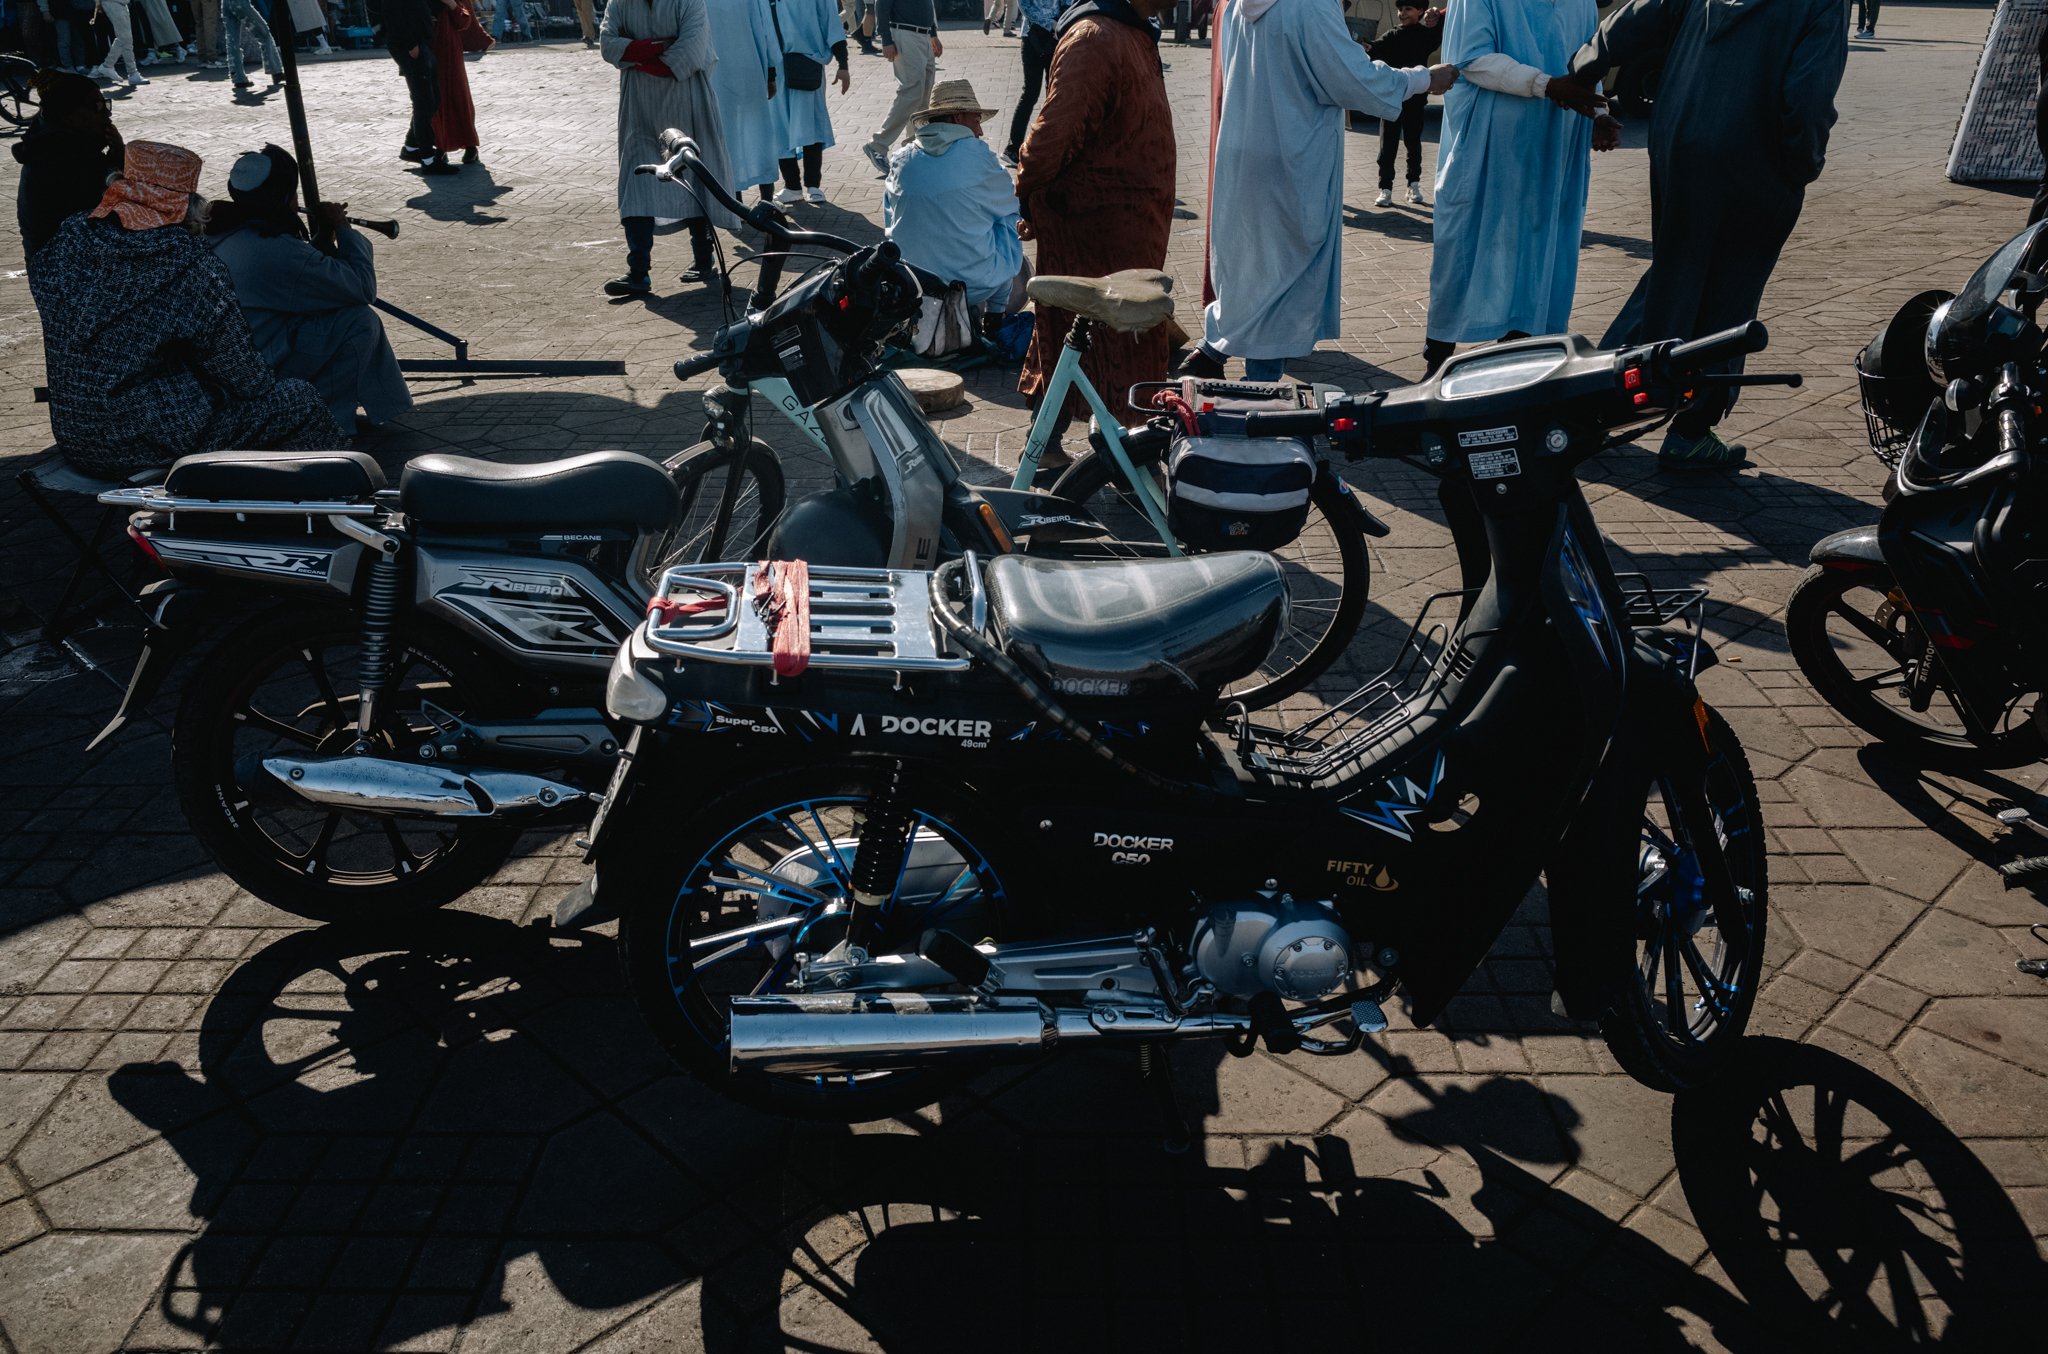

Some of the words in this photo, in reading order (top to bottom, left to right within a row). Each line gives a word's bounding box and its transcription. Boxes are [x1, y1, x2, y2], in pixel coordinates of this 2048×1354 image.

[1018, 514, 1071, 528] RIBEIRO
[298, 568, 327, 576] BECANE
[458, 575, 565, 596] RIBEIRO
[407, 646, 455, 678] BECANE
[1048, 676, 1131, 696] DOCKER
[715, 715, 756, 726] Super
[881, 715, 993, 738] DOCKER
[751, 725, 779, 734] C50
[214, 783, 240, 829] BECANE
[1093, 831, 1174, 852] DOCKER
[1111, 851, 1151, 865] C50
[1326, 859, 1375, 875] FIFTY
[1346, 875, 1368, 887] OIL
[886, 1021, 988, 1040] DOER
